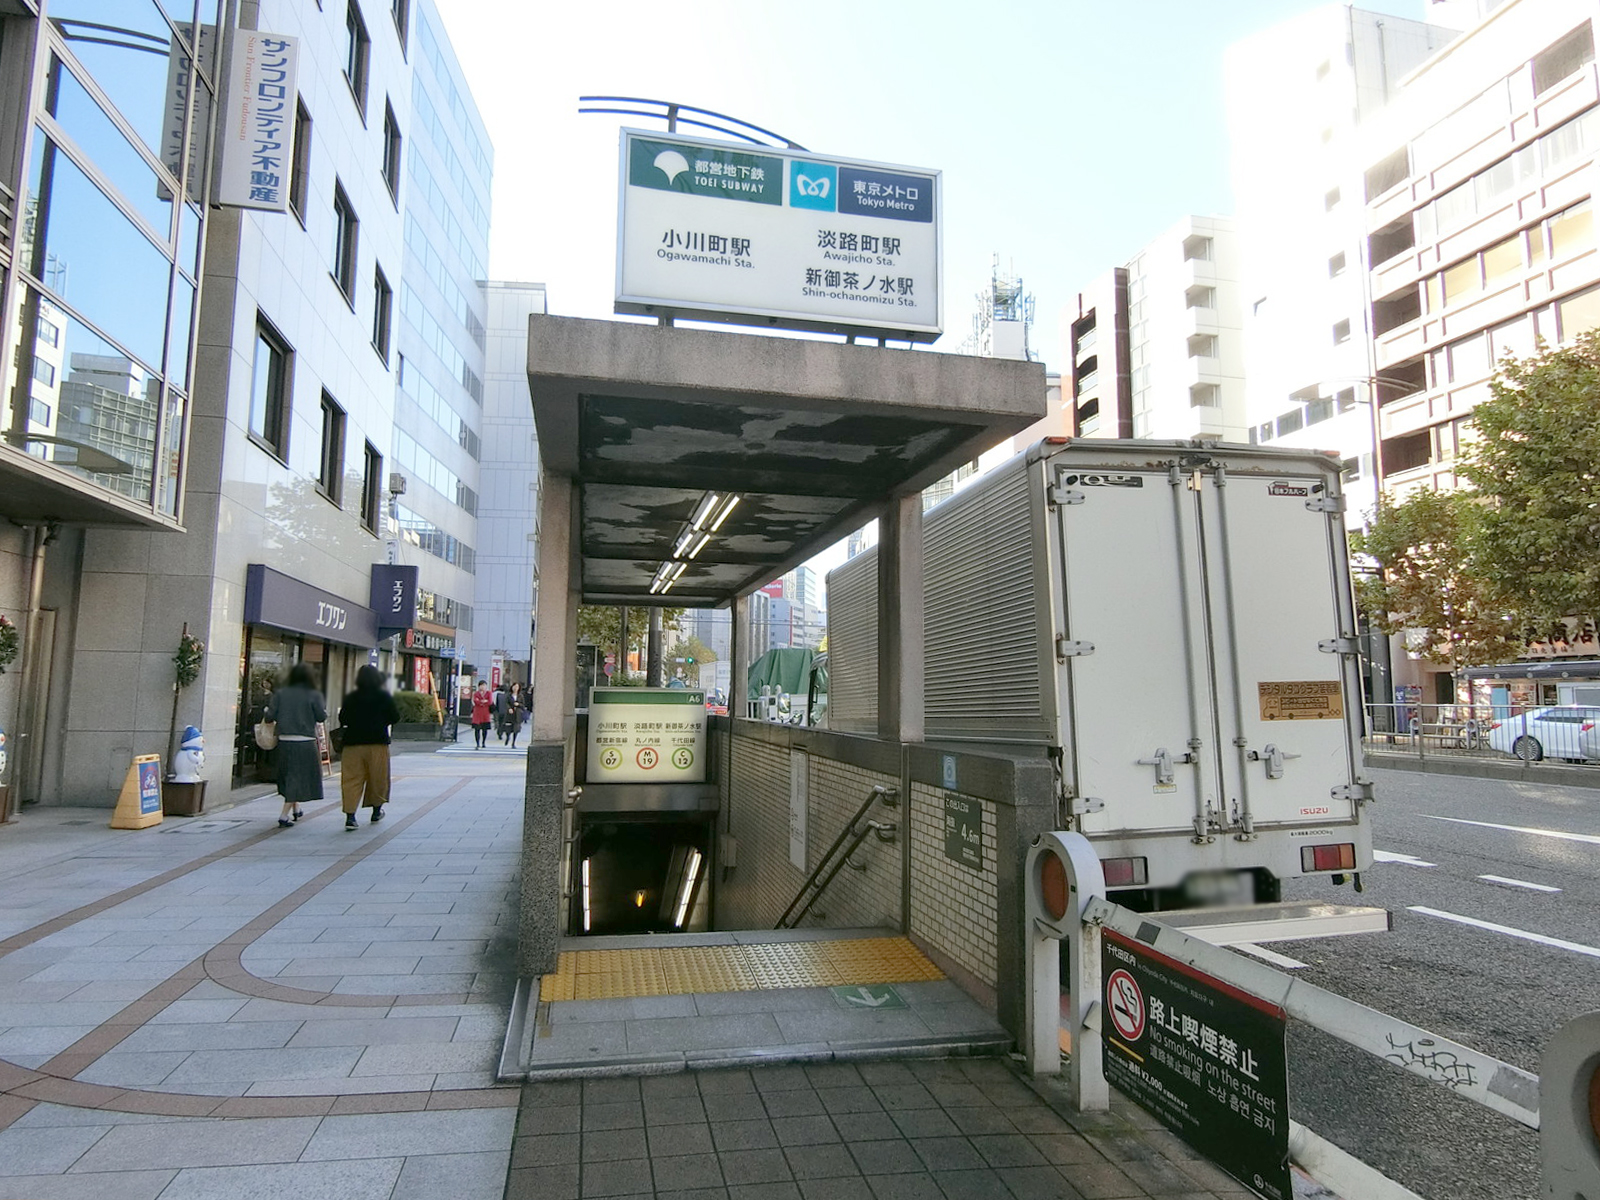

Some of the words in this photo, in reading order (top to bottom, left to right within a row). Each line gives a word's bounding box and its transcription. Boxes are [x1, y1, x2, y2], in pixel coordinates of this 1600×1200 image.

[246, 35, 257, 55] Sun
[243, 56, 255, 94] Frontier
[239, 96, 252, 141] Fudousan
[248, 38, 291, 204] サンフロンティア不動産
[694, 159, 765, 182] 都営地下鉄
[694, 176, 717, 187] TOEI
[721, 179, 764, 194] SUBWAY
[852, 180, 919, 201] 東京メトロ
[857, 195, 884, 209] Tokyo
[886, 198, 915, 211] Metro
[661, 228, 751, 258] 小川町駅
[817, 229, 902, 257] 淡路町駅
[656, 248, 732, 267] Ogawamachi
[734, 256, 756, 270] Sta.
[823, 250, 873, 266] Awajicho
[875, 254, 896, 267] Sta.
[805, 267, 914, 296] 新御茶ノ水駅
[802, 287, 895, 306] Shin-ochanomizu
[897, 296, 918, 308] Sta.
[392, 580, 404, 613] エフワン
[315, 600, 348, 630] エフワン
[688, 695, 701, 703] A6
[597, 722, 628, 730] 小川町駅
[634, 722, 662, 730] 淡路町駅
[665, 722, 702, 730] 新御茶ノ水駅
[605, 758, 617, 766] 07
[1300, 807, 1329, 815] ISUZU
[961, 823, 980, 845] 4.6m
[1106, 943, 1137, 967] 千代田区内
[1150, 995, 1260, 1083] 路上喫煙禁止
[1150, 1024, 1162, 1044] No
[1163, 1034, 1203, 1074] smoking
[1205, 1060, 1220, 1077] on
[1221, 1068, 1240, 1092] the
[1241, 1079, 1277, 1115] street
[1207, 1078, 1227, 1104] 노상
[1230, 1092, 1251, 1120] 흡연
[1253, 1108, 1276, 1136] 금지
